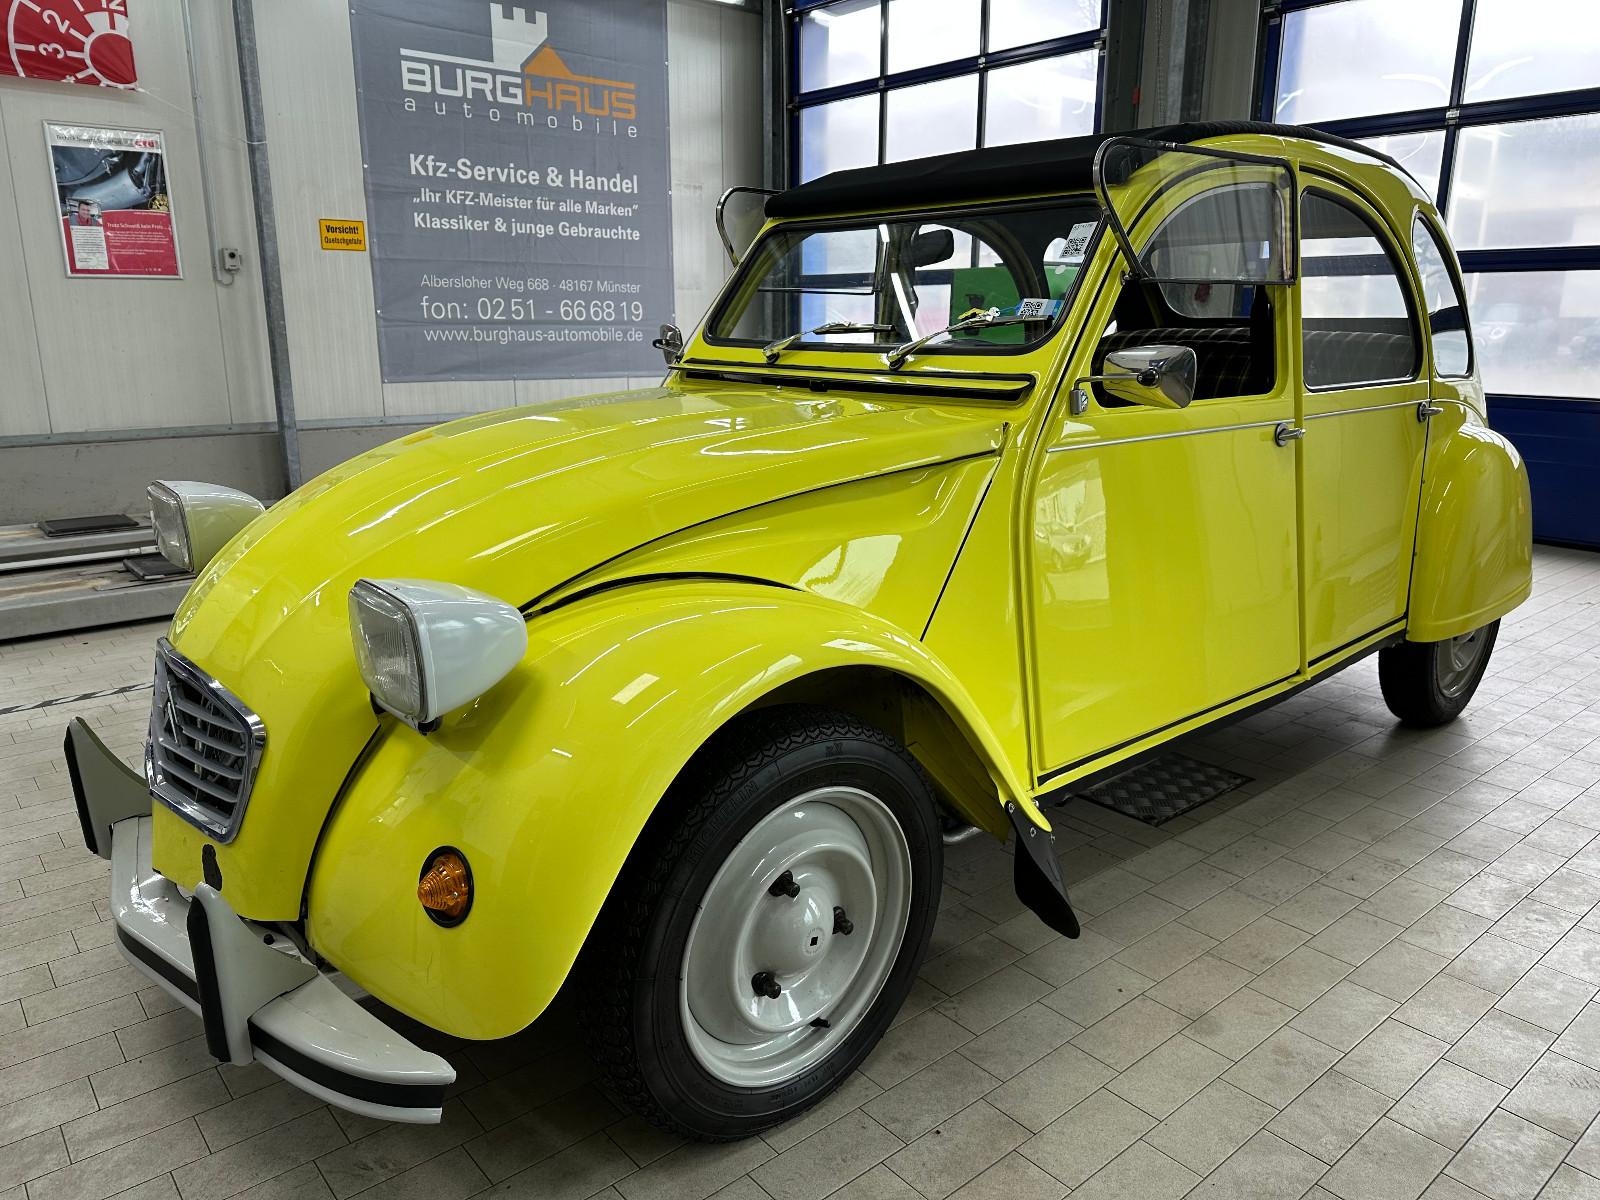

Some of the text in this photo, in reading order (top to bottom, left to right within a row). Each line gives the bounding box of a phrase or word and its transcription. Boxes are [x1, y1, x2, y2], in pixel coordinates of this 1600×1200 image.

[42, 9, 70, 34] 2
[38, 43, 65, 59] 3
[409, 153, 638, 193] Kfz-Service & Handel
[446, 189, 532, 209] KFZ-Meister
[536, 196, 555, 211] für
[559, 199, 582, 213] alle
[325, 224, 359, 234] Vorsicht!
[414, 212, 640, 241] Klassiker & junge Gebrauchte
[420, 274, 492, 289] Albersloher
[495, 277, 524, 292] Weg
[527, 278, 549, 291] 668
[559, 280, 593, 292] 48167
[597, 280, 641, 293] Münster
[420, 295, 468, 319] fon:
[424, 326, 644, 344] www.burghaus-automobile.de
